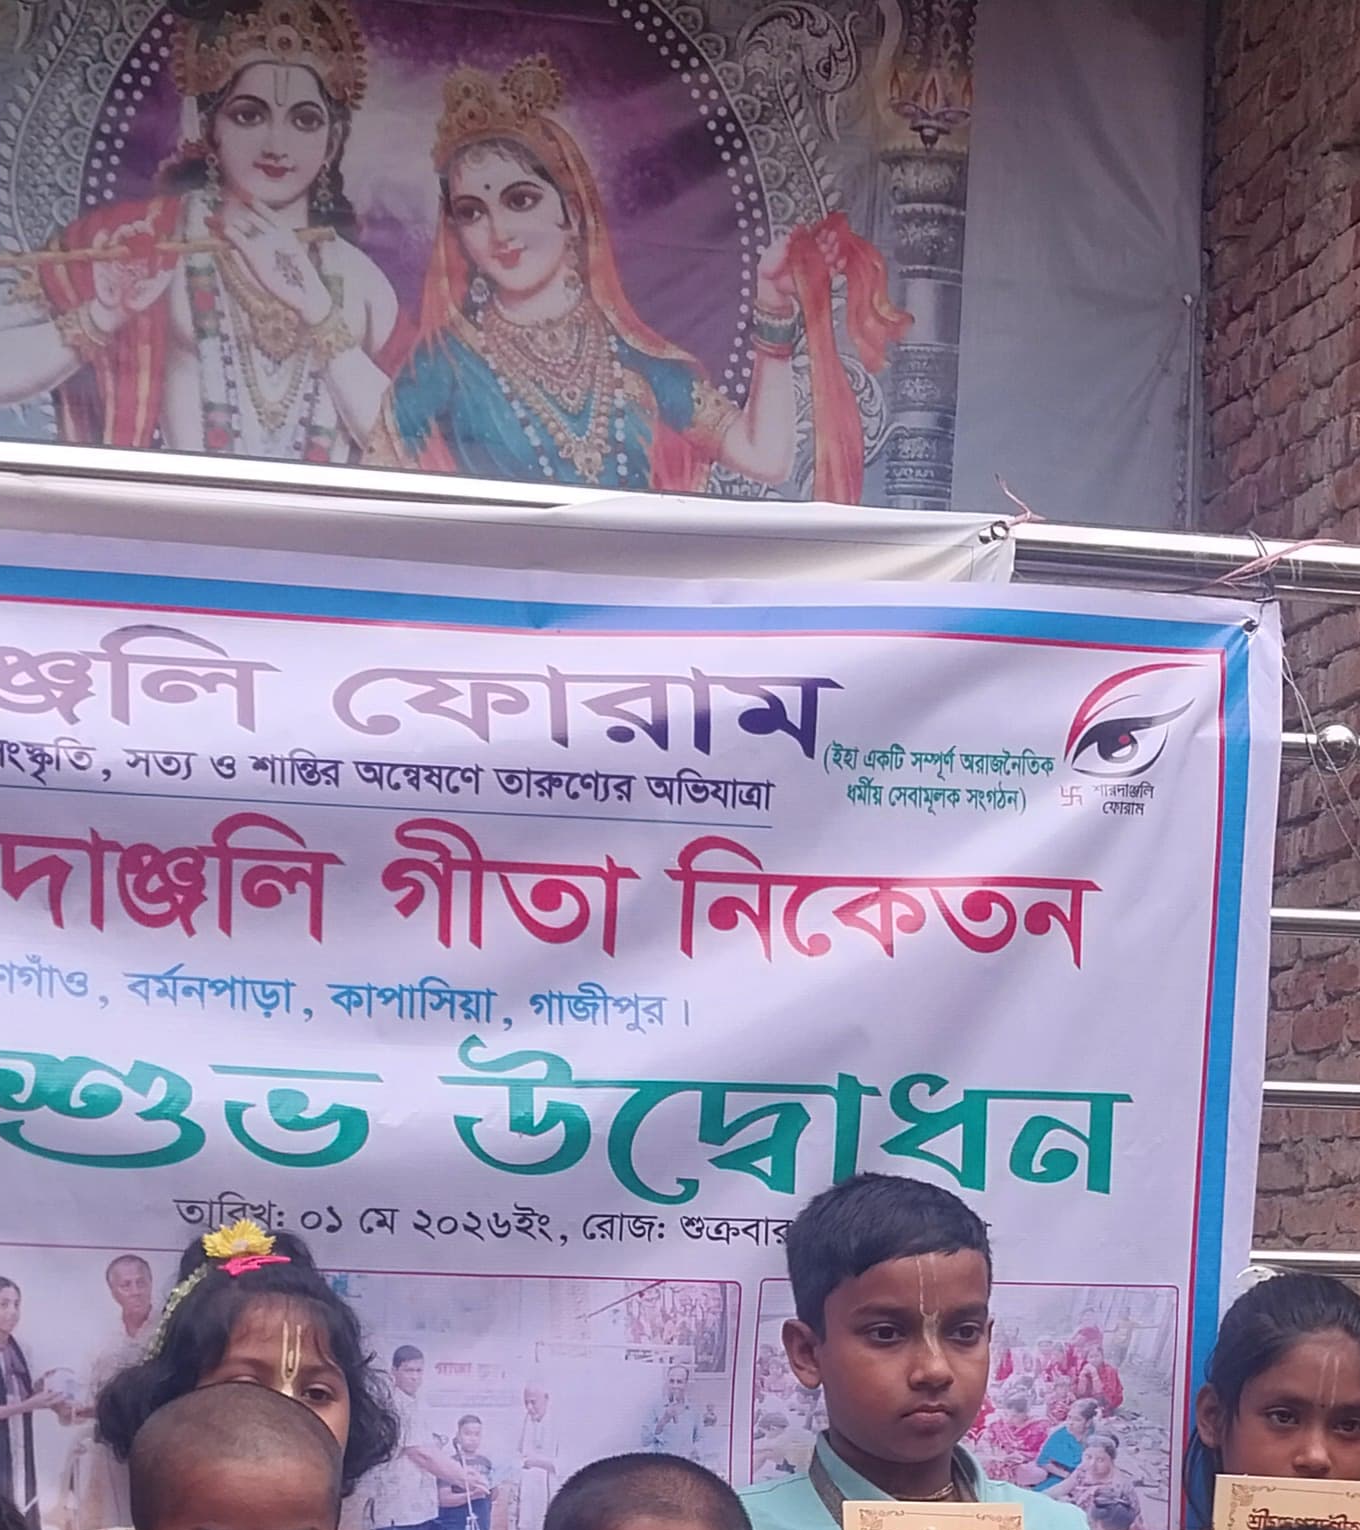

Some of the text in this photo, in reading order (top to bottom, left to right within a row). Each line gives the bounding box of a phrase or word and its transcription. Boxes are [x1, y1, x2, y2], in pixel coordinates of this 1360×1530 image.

[332, 663, 844, 762] ফোরাম
[125, 750, 197, 781] সত্য
[210, 755, 237, 782] ও
[252, 750, 342, 789] শান্তির
[352, 759, 484, 797] অন্বেষণে
[493, 767, 633, 804] তারুণ্যের
[647, 770, 775, 813] অভিযাত্রা
[864, 743, 904, 773] একটি
[910, 745, 955, 780] সম্পূর্ণ
[961, 749, 1056, 777] অরাজনৈতিক
[847, 777, 1027, 814] ধর্মীয় সেবামূলক সংগঠন)
[1092, 782, 1154, 800] শারদাঞ্জলি
[1103, 799, 1145, 816] ফোরাম
[382, 817, 641, 960] গীতা
[665, 835, 1103, 969] নিকেতন
[439, 1034, 1133, 1205] উদ্বোধন
[301, 1211, 343, 1233] ০১
[360, 1206, 400, 1238] মে
[582, 1208, 666, 1243] রোজ:
[681, 1213, 792, 1246] শুক্রবার
